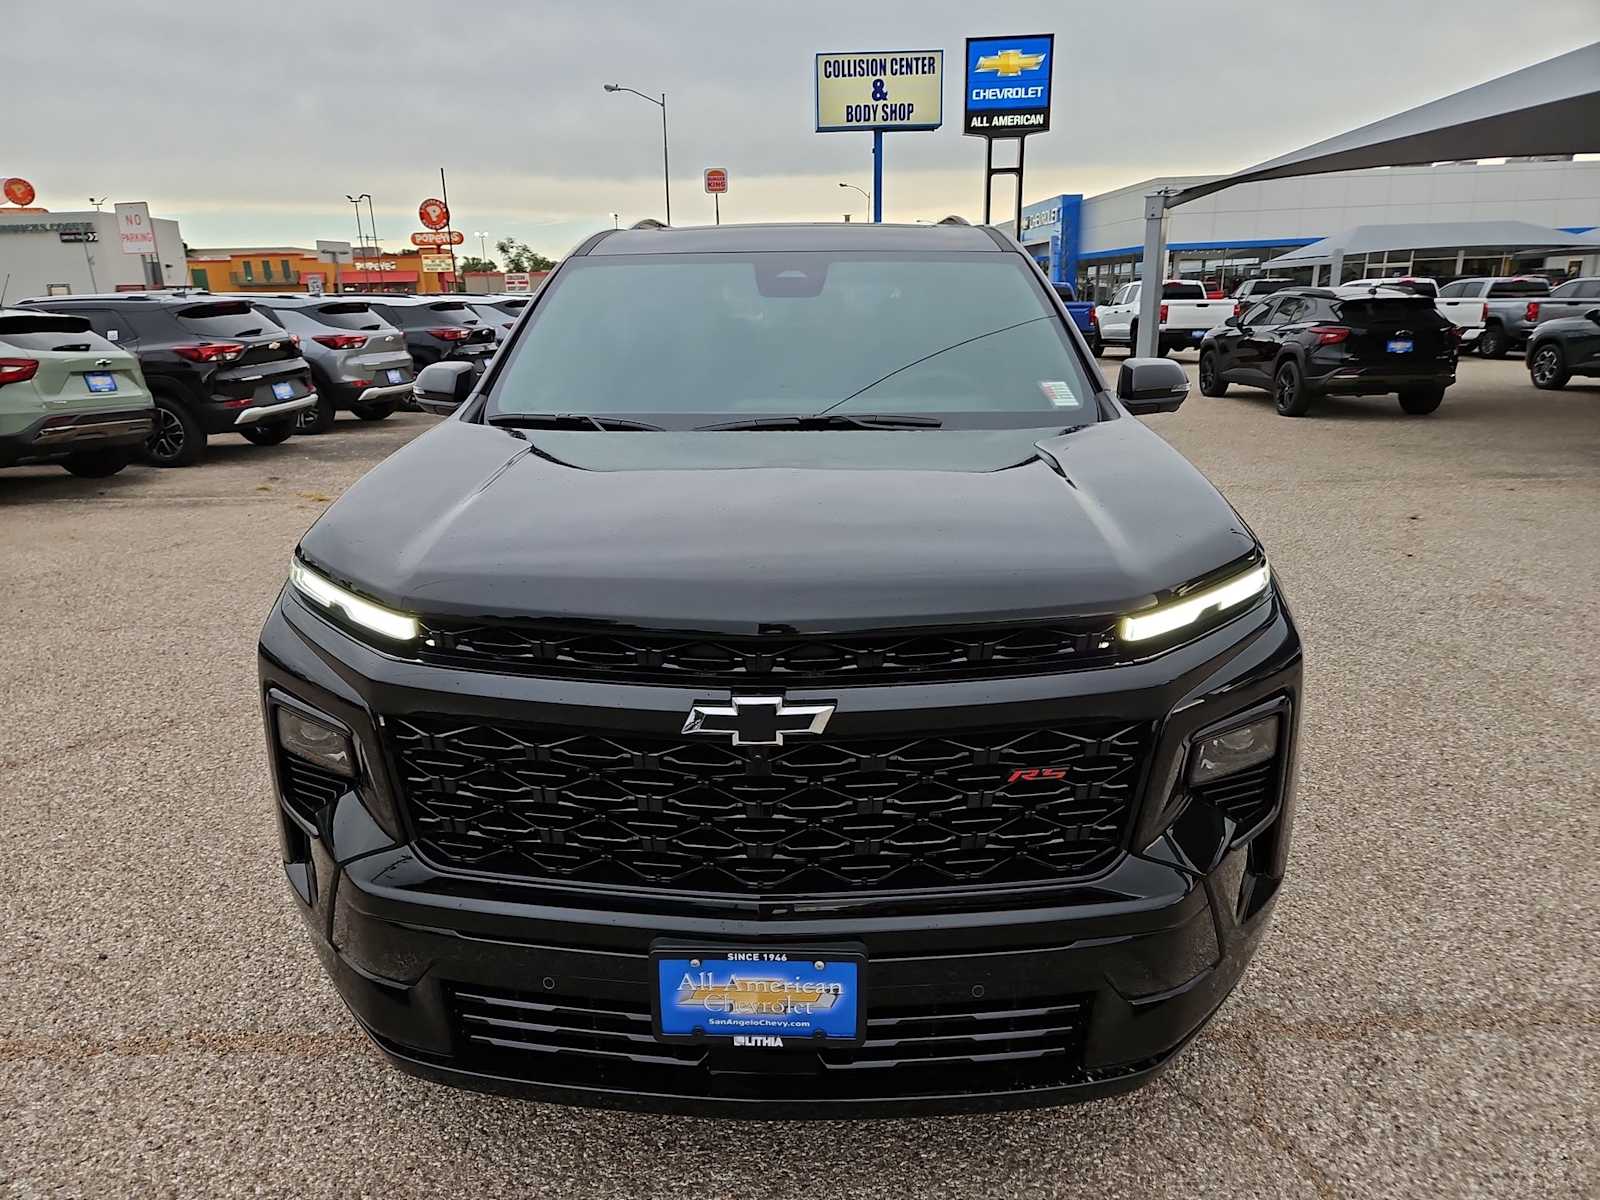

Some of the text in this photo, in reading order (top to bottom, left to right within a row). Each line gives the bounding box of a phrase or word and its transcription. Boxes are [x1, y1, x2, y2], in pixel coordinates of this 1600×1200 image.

[824, 56, 936, 79] COLLISION CENTER
[871, 79, 889, 102] &
[972, 86, 1044, 101] CHEVROLET
[846, 103, 914, 123] BODY SHOP
[971, 114, 1044, 128] ALL AMERICAN
[126, 214, 141, 226] NO
[121, 232, 153, 242] PARKING
[1008, 768, 1069, 783] RS
[727, 953, 788, 962] SINCE 1946
[676, 971, 844, 994] All American
[703, 994, 814, 1015] Chevrolet
[708, 1018, 811, 1028] SanAngeloChevy.com
[744, 1036, 783, 1048] LITHIA
